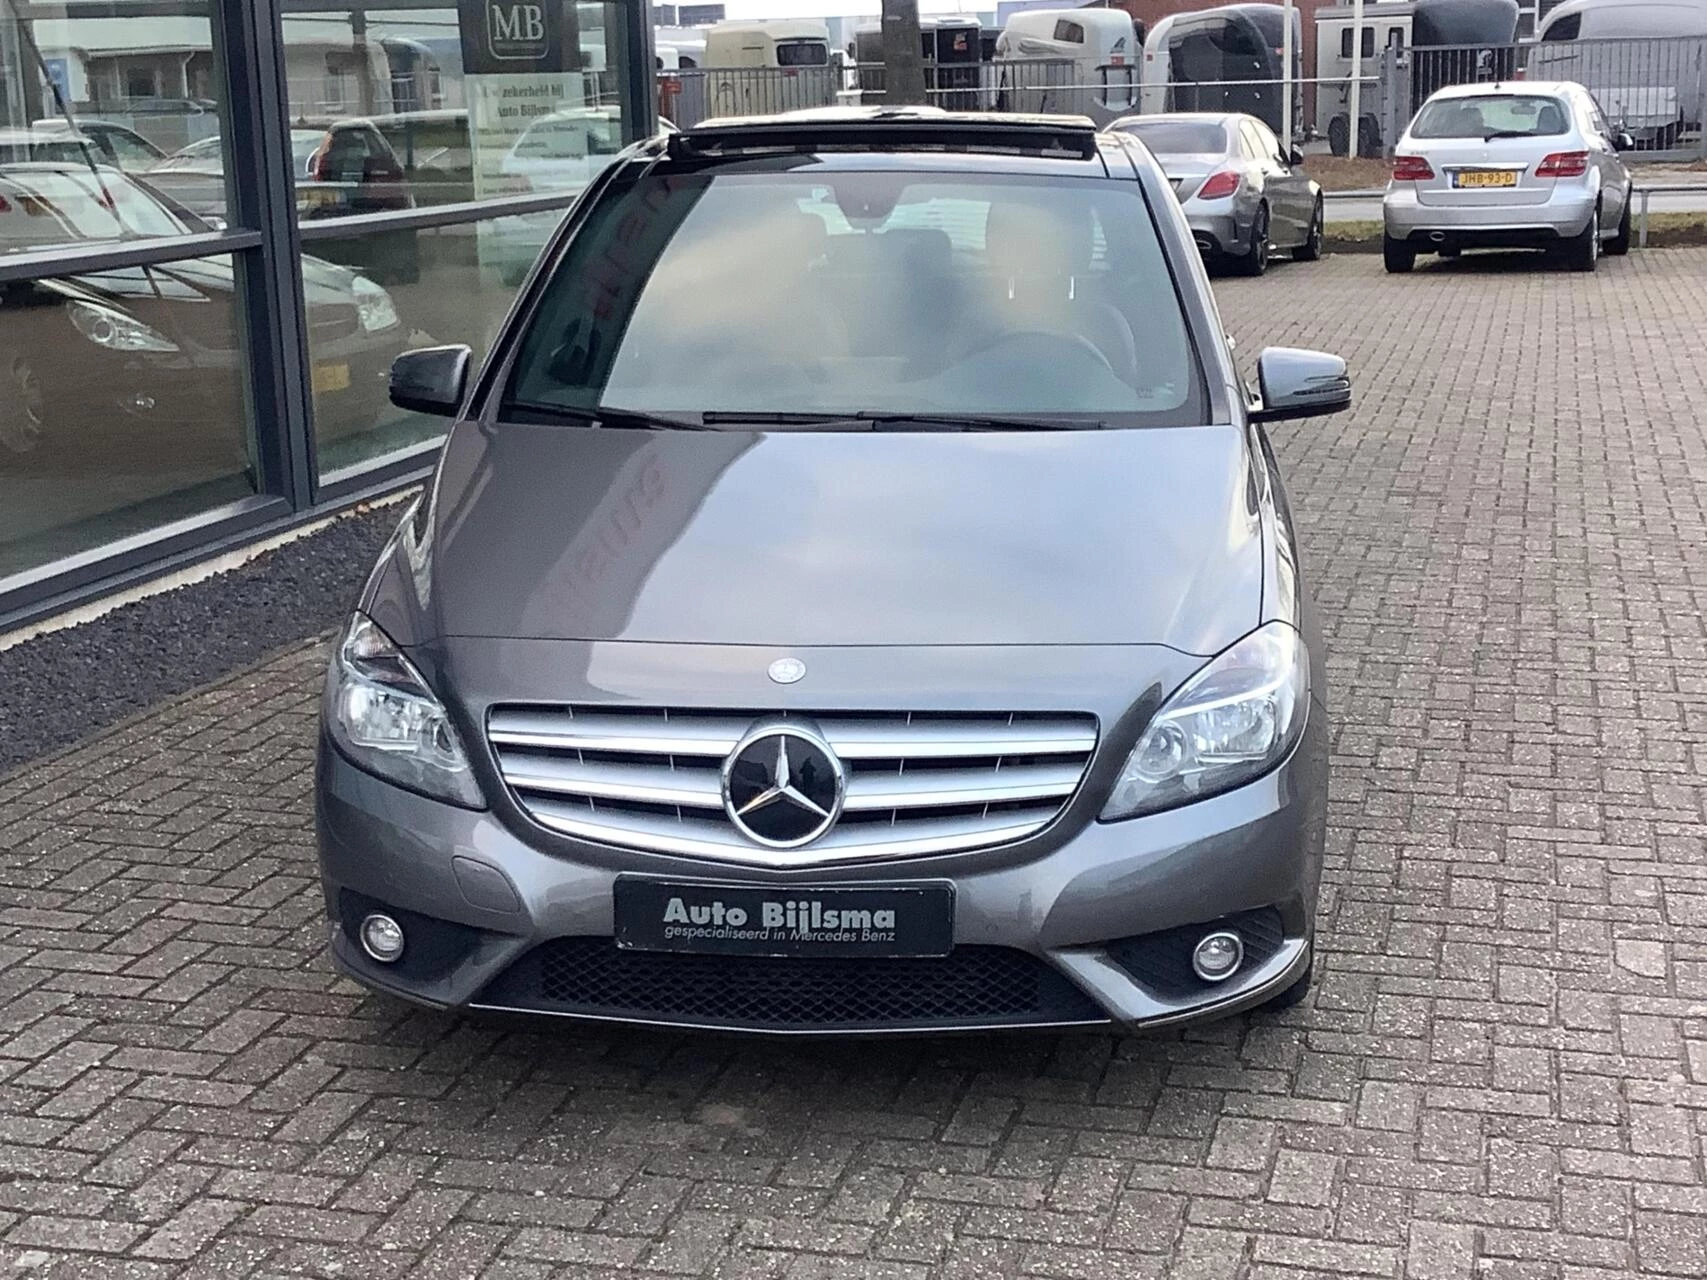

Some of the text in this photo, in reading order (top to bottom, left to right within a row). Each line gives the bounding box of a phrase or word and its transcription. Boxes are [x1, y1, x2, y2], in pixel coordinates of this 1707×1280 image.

[492, 4, 544, 40] MB
[1462, 173, 1513, 184] JHB-93-D
[663, 897, 895, 934] Auto Bijlsma
[664, 925, 895, 941] gespecialiseerd in Mercedes Benz
